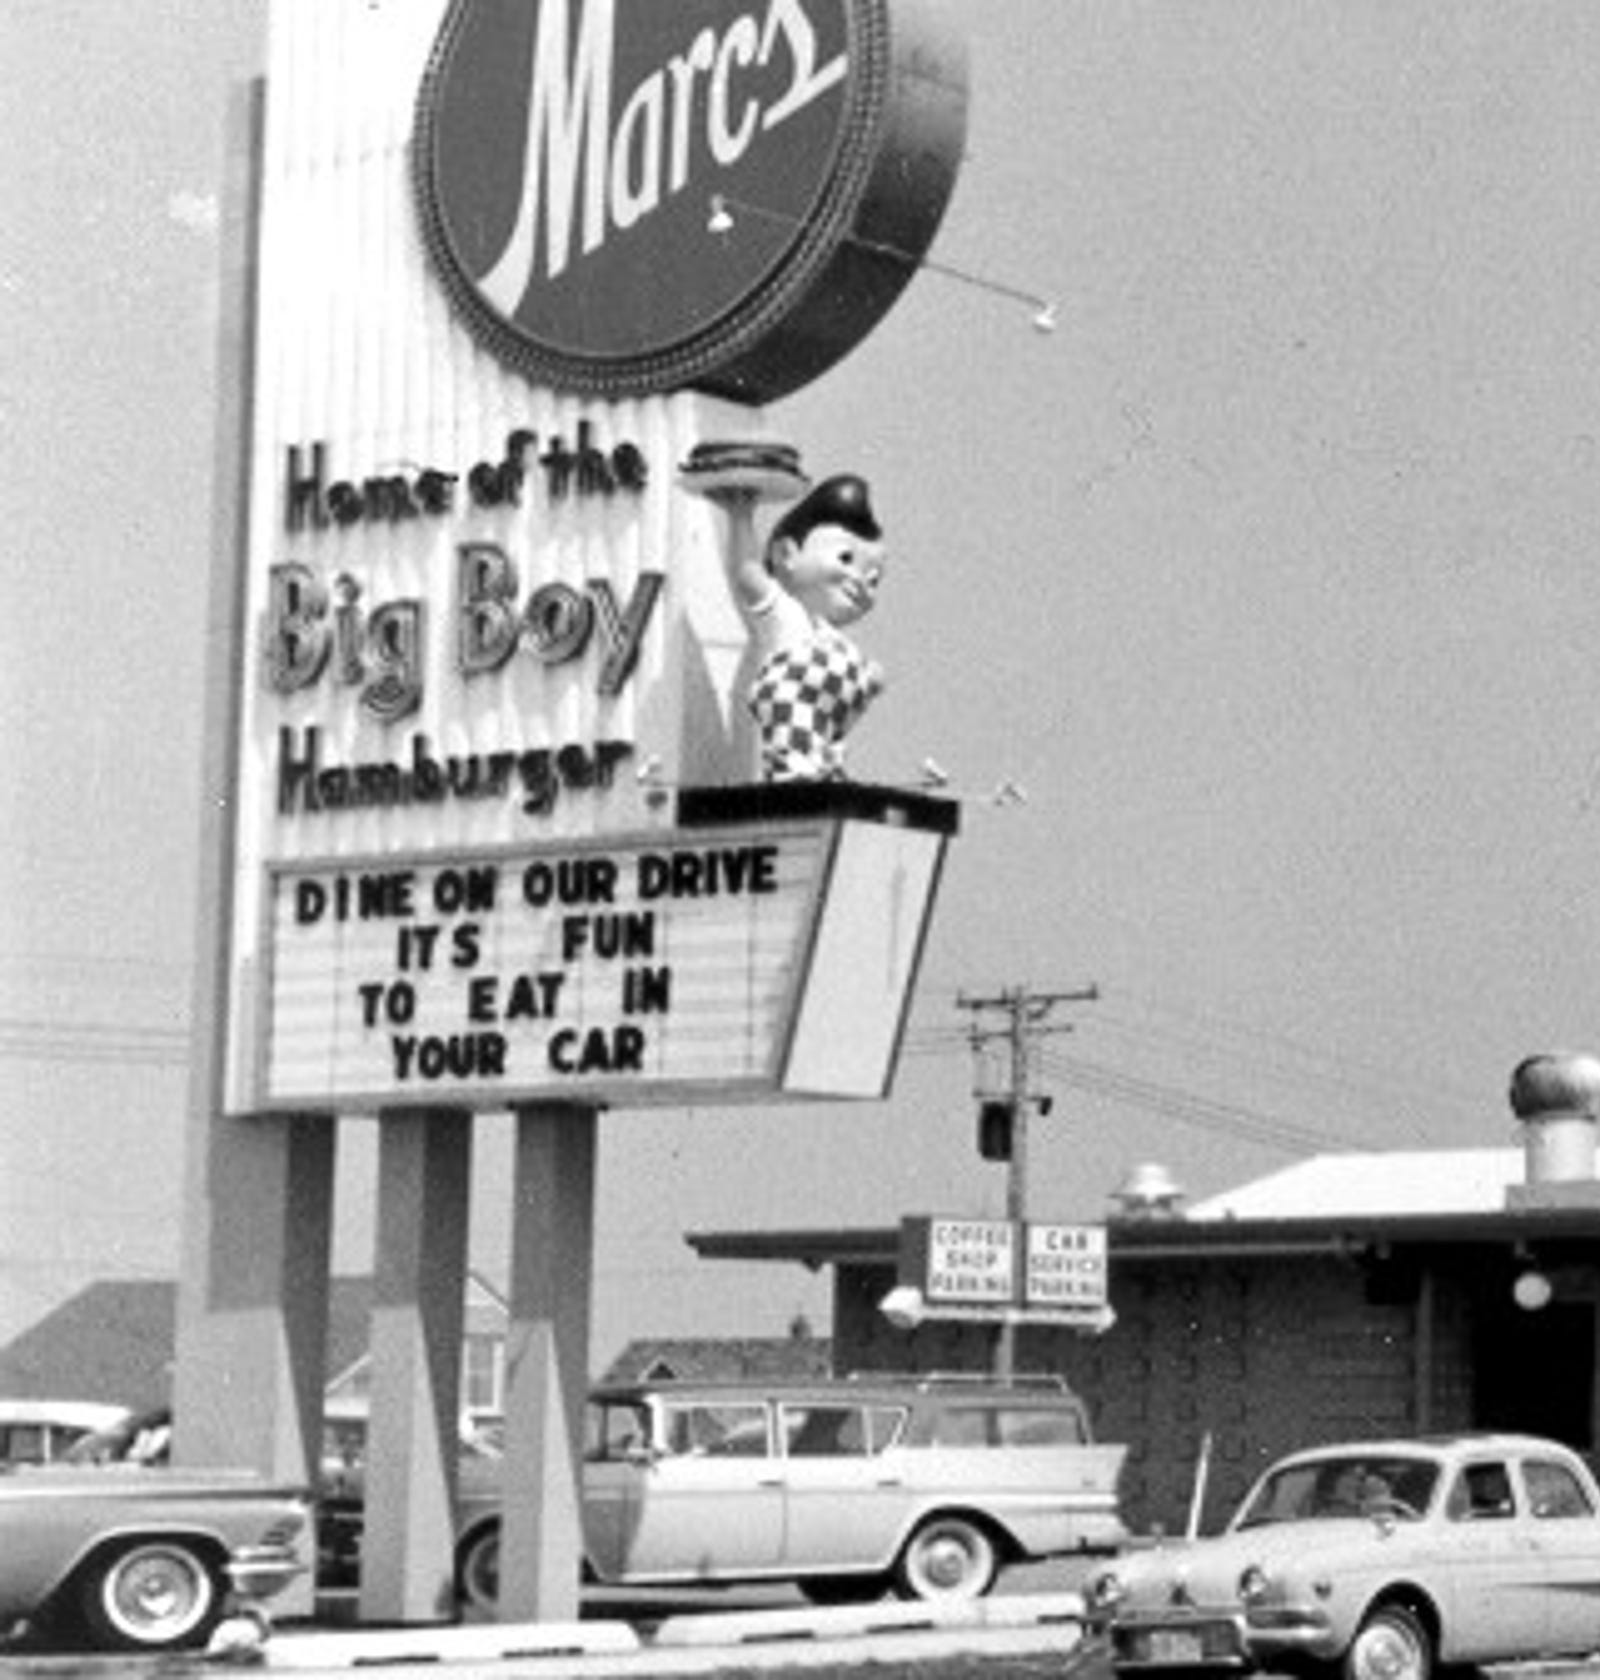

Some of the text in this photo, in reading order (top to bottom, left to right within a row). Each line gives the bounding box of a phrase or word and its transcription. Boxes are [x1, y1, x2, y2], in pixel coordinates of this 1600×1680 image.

[285, 419, 648, 534] Home of the
[266, 541, 667, 726] Big Boy
[278, 723, 635, 818] Hamburger
[295, 846, 779, 926] DINE ON OUR DRIVE
[397, 911, 656, 971] ITS FUN
[358, 966, 672, 1027] TO EAT IN
[391, 1026, 645, 1080] YOUR CAR
[935, 1225, 1009, 1247] COFFEE
[946, 1250, 998, 1270] SHOP
[1046, 1229, 1090, 1252] CAR
[931, 1272, 1010, 1293] PARKING
[1029, 1253, 1103, 1274] SERVICE
[1029, 1275, 1105, 1297] PARKING
